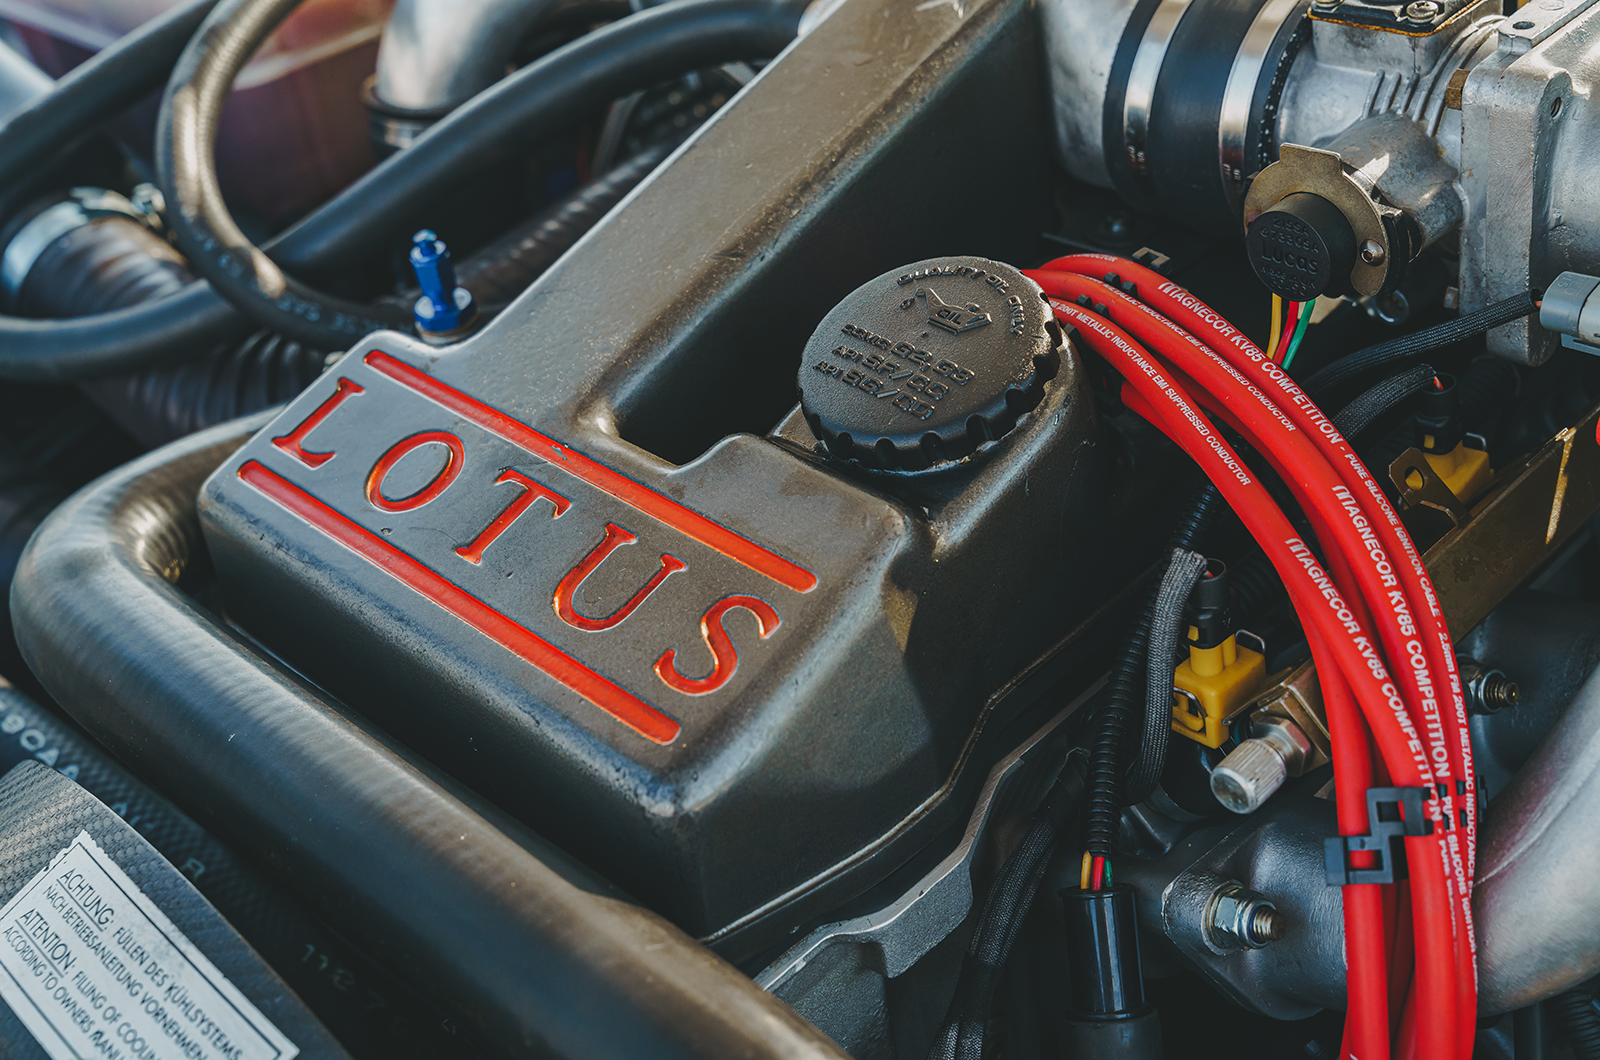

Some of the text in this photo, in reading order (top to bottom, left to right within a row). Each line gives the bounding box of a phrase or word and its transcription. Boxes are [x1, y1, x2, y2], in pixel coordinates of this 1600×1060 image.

[897, 265, 1025, 337] QUALITY OIL ONLY
[936, 308, 962, 326] OIL
[1157, 281, 1236, 337] MAGNECOR
[832, 345, 949, 401] API SF/CC
[933, 358, 975, 386] G3
[1230, 332, 1266, 362] KV85
[813, 360, 936, 421] API SG/CD
[1261, 360, 1344, 444] COMPETITION
[1344, 453, 1370, 480] PURE
[1365, 479, 1399, 527] SILICONE
[270, 376, 782, 697] LOTUS
[1056, 303, 1080, 317] 200T
[1077, 312, 1114, 339] METALLIC
[1110, 334, 1156, 377] INDUCTANCE
[1152, 373, 1171, 391] EMI
[1165, 388, 1211, 437] SUPPRESSED
[1206, 435, 1252, 486] CONDUCTOR
[1285, 538, 1360, 635] MAGNECOR
[1353, 635, 1388, 680] KV85
[1381, 682, 1443, 822] COMPETITION
[1394, 527, 1424, 576] IGNITION
[1103, 283, 1140, 307] METALLIC
[1138, 303, 1186, 337] INDUCTANCE
[1184, 335, 1206, 348] EMI
[1199, 346, 1250, 386] SUPPRESSED
[1247, 385, 1296, 432] CONDUCTOR
[1332, 485, 1398, 588] MAGNECOR
[1387, 590, 1417, 636] KV85
[1406, 639, 1451, 777] COMPETITION
[1447, 834, 1467, 896] SILICONE
[1420, 577, 1441, 617] CABLE
[1449, 674, 1461, 693] FM
[1459, 727, 1474, 790] METALLIC
[1466, 793, 1477, 877] INDUCTANCE
[43, 885, 67, 914] NACH
[62, 907, 143, 997] BETRIEBSANLEITUNG
[60, 868, 115, 930] ACHTUNG:
[113, 926, 150, 967] FÜLLEN
[144, 961, 169, 987] DES
[2, 926, 47, 977] ACCORDING
[42, 972, 59, 990] TO
[53, 986, 95, 1034] OWNERS
[20, 908, 78, 975] ATTENTION:
[72, 971, 107, 1010] FILLING
[102, 1005, 122, 1025] OF
